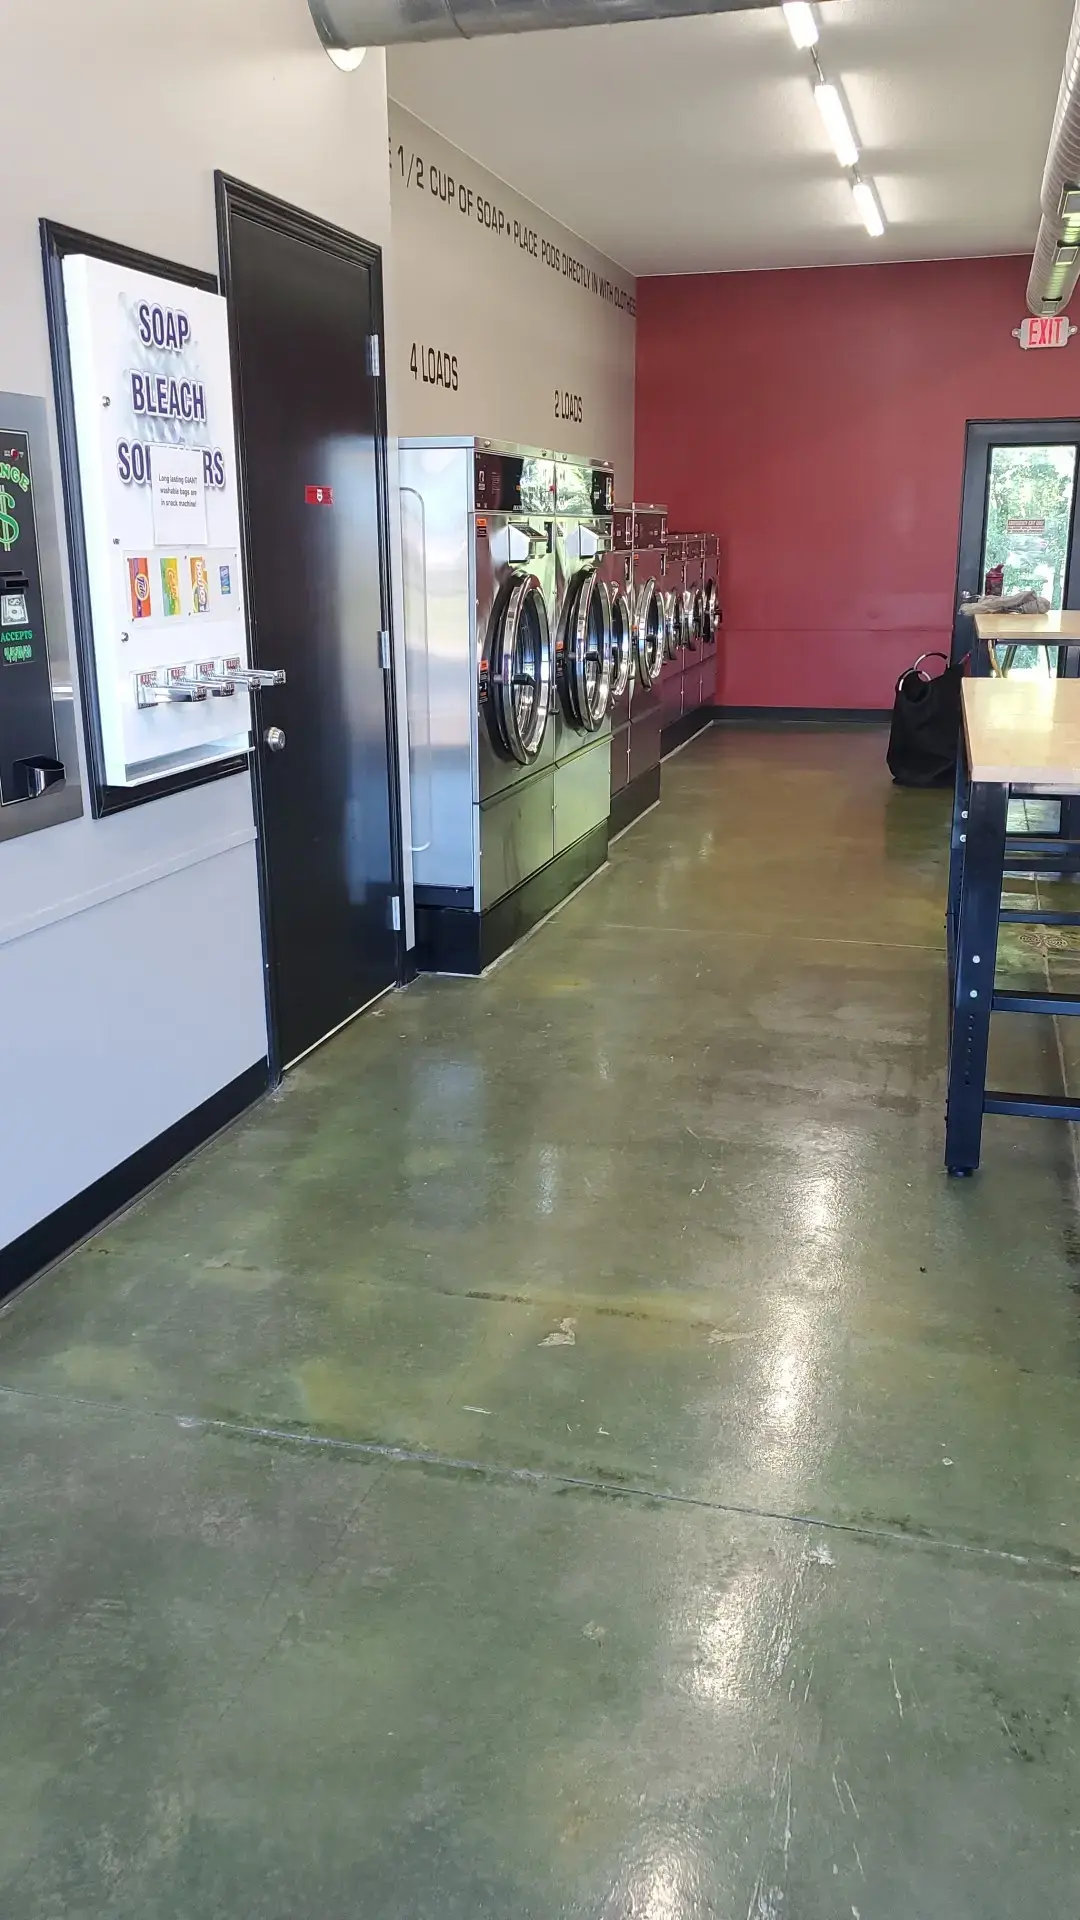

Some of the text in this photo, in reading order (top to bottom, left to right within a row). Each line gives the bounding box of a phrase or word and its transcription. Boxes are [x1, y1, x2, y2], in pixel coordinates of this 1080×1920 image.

[397, 145, 424, 189] 1/2
[430, 165, 455, 204] CUP
[458, 184, 473, 216] OF
[477, 196, 504, 236] SOAP
[513, 219, 538, 258] PLACE
[541, 238, 560, 271] PODS
[562, 252, 591, 290] DIRECTLY
[592, 271, 598, 294] IN
[599, 277, 613, 304] WITH
[138, 302, 190, 350] SOAP
[1029, 318, 1063, 345] EXIT
[410, 342, 459, 391] 4 LOADS
[131, 372, 205, 420] BLEACH
[554, 389, 583, 423] 2 LOADS
[159, 473, 170, 484] Long
[136, 574, 147, 599] Tide
[0, 630, 33, 642] ACCEPTS
